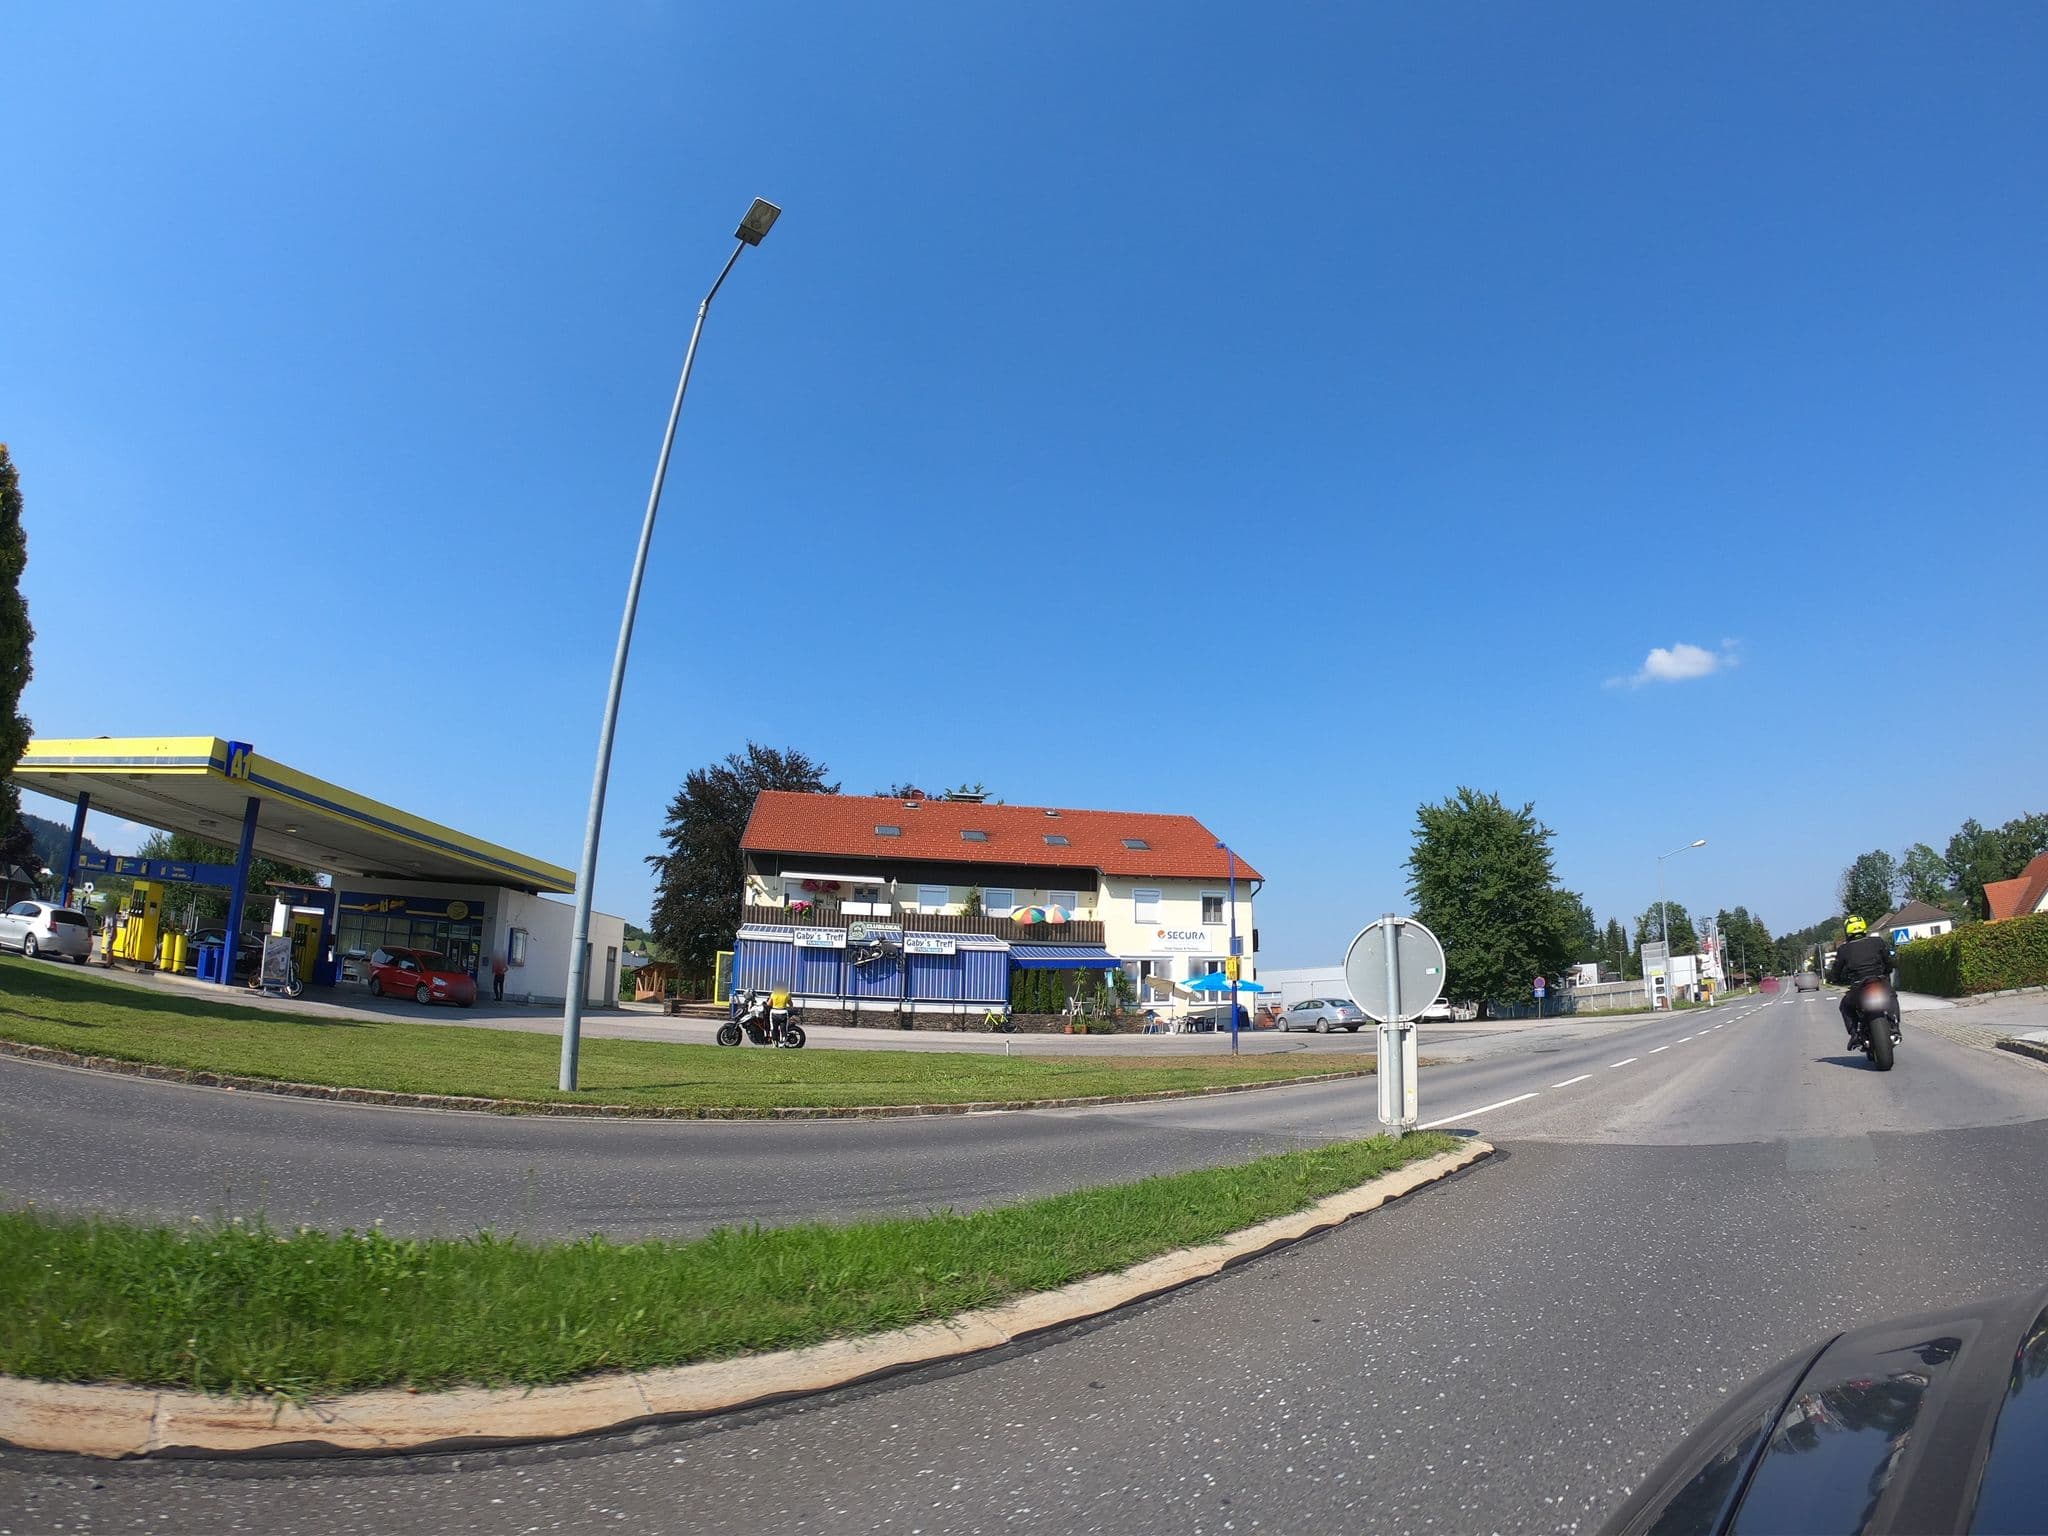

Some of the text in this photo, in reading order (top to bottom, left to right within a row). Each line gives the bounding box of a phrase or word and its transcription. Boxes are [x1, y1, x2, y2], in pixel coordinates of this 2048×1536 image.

[230, 749, 254, 779] A1
[826, 932, 844, 941] Treff
[1167, 930, 1206, 940] SECURA
[935, 939, 953, 948] Treff
